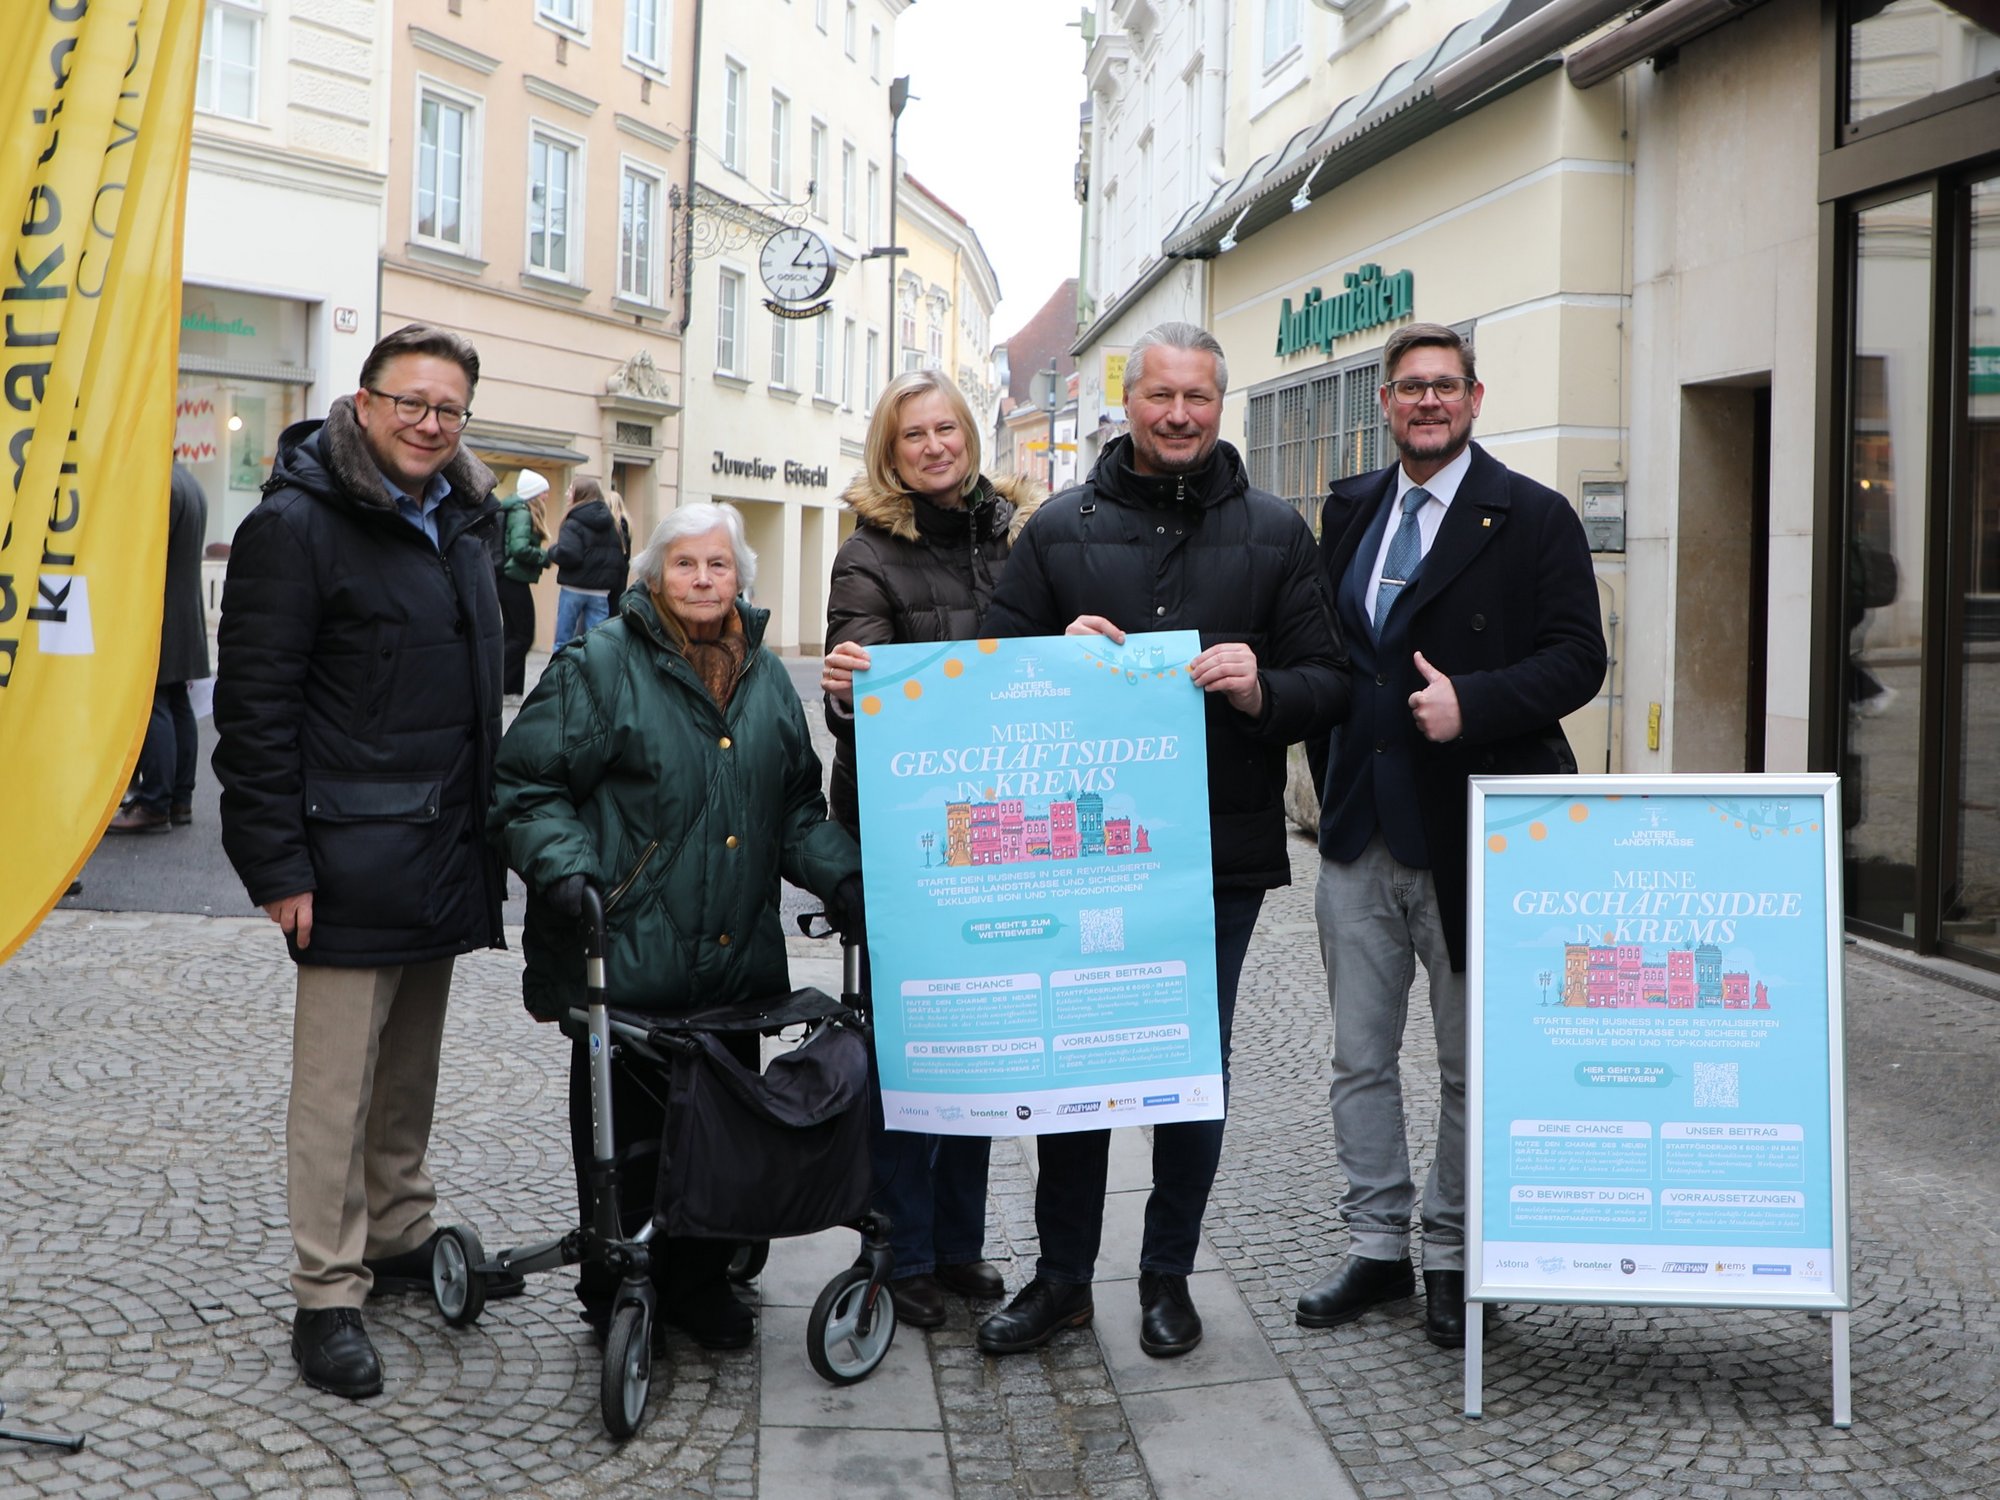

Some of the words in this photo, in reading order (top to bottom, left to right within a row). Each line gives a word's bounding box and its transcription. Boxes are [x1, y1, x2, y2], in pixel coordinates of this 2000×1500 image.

[769, 303, 825, 317] GOLDSCHMIED
[1275, 263, 1414, 357] Antiquitäten
[339, 311, 354, 324] 47
[712, 450, 777, 480] Juwelier
[783, 459, 828, 488] Göschl
[1008, 680, 1052, 691] UNTERE
[990, 687, 1072, 700] LANDSTRASSE
[991, 720, 1075, 743] MEINE
[890, 735, 1180, 777] GESCHÄFTSIDEE
[956, 781, 984, 800] IN
[994, 766, 1117, 798] KREMS
[1632, 830, 1676, 839] UNTERE
[1614, 838, 1695, 847] LANDSTRASSE
[917, 876, 957, 888] STARTE
[960, 875, 984, 885] DEIN
[987, 871, 1036, 883] BUSINESS
[1039, 870, 1050, 879] IN
[1052, 868, 1073, 878] DER
[1076, 862, 1160, 876] REVITALISIERTEN
[1613, 870, 1696, 888] MEINE
[928, 885, 979, 897] UNTEREN
[982, 879, 1060, 893] LANDSTRASSE
[1062, 878, 1083, 887] UND
[1088, 874, 1130, 885] SICHERE
[1132, 872, 1150, 882] DIR
[936, 895, 994, 907] EXKLUSIVE
[997, 893, 1022, 902] BONI
[1024, 890, 1047, 900] UND
[1050, 883, 1143, 897] TOP-KONDITIONEN!
[1512, 885, 1803, 917] GESCHÄFTSIDEE
[970, 922, 991, 932] HIER
[994, 920, 1028, 930] GEHT'S
[1031, 918, 1051, 928] ZUM
[1576, 924, 1603, 941] IN
[1614, 917, 1737, 944] KREMS
[978, 927, 1044, 939] WETTBEWERB
[1074, 970, 1110, 982] UNSER
[1116, 966, 1162, 978] BEITRAG
[928, 982, 961, 992] DEINE
[965, 979, 1014, 990] CHANCE
[1533, 1016, 1573, 1025] STARTE
[1575, 1017, 1599, 1025] DEIN
[1602, 1017, 1651, 1026] BUSINESS
[1654, 1018, 1665, 1026] IN
[1668, 1018, 1689, 1027] DER
[1692, 1018, 1780, 1028] REVITALISIERTEN
[1062, 1028, 1181, 1046] VORRAUSSETZUNGEN
[1543, 1027, 1594, 1036] UNTEREN
[1596, 1027, 1675, 1037] LANDSTRASSE
[1678, 1028, 1700, 1037] UND
[1704, 1029, 1747, 1038] SICHERE
[1750, 1029, 1768, 1039] DIR
[912, 1045, 928, 1054] SO
[931, 1044, 988, 1054] BEWIRBST
[991, 1043, 1008, 1053] DU
[1011, 1041, 1037, 1051] DICH
[1551, 1037, 1608, 1046] EXKLUSIVE
[1611, 1038, 1636, 1047] BONI
[1639, 1038, 1661, 1047] UND
[1665, 1038, 1761, 1049] TOP-KONDITIONEN!
[1583, 1066, 1604, 1074] HIER
[1607, 1066, 1641, 1075] GEHT'S
[1644, 1067, 1664, 1075] ZUM
[1591, 1074, 1656, 1083] WETTBEWERB
[970, 1107, 1008, 1117] brantner
[1110, 1097, 1136, 1107] krems
[1538, 1124, 1571, 1133] DEINE
[1575, 1124, 1623, 1134] CHANCE
[1685, 1126, 1723, 1136] UNSER
[1729, 1127, 1778, 1137] BEITRAG
[1517, 1190, 1534, 1199] SO
[1537, 1190, 1595, 1200] BEWIRBST
[1599, 1191, 1615, 1200] DU
[1618, 1192, 1645, 1201] DICH
[1670, 1192, 1796, 1204] VORRAUSSETZUNGEN
[1496, 1258, 1529, 1269] Astoria
[1573, 1259, 1613, 1269] brantner
[1718, 1260, 1746, 1270] krems
